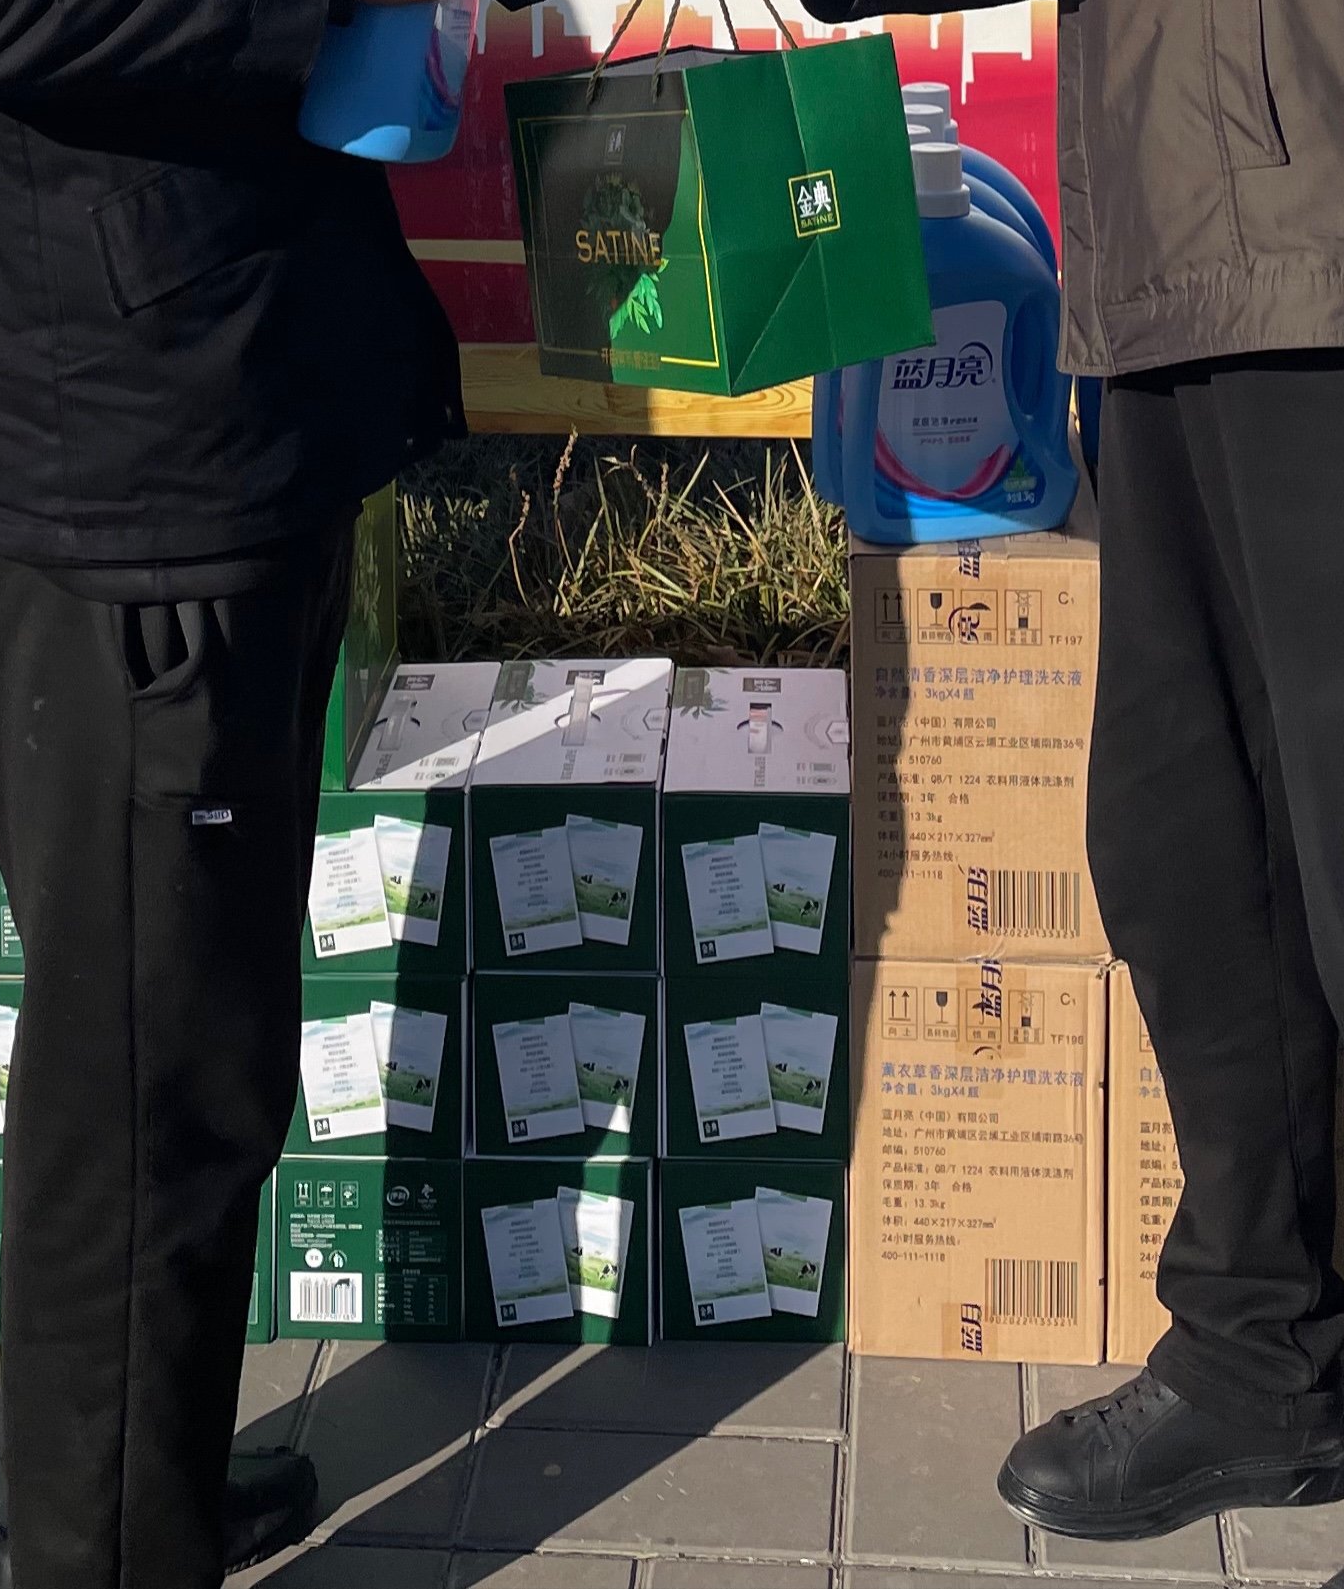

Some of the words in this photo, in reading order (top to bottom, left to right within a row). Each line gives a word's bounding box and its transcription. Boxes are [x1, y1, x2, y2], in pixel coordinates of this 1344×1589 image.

[797, 179, 833, 219] 金典
[800, 213, 835, 227] SATINE
[575, 229, 662, 265] SATINE
[890, 343, 994, 390] 蓝月亮
[1049, 635, 1083, 646] TF197
[875, 667, 1083, 687] 自然清香深层洁净护理洗衣液
[959, 775, 981, 785] 1224
[881, 1062, 1084, 1087] 薰衣草香深层洁净护理洗衣液
[962, 1165, 983, 1175] 1224
